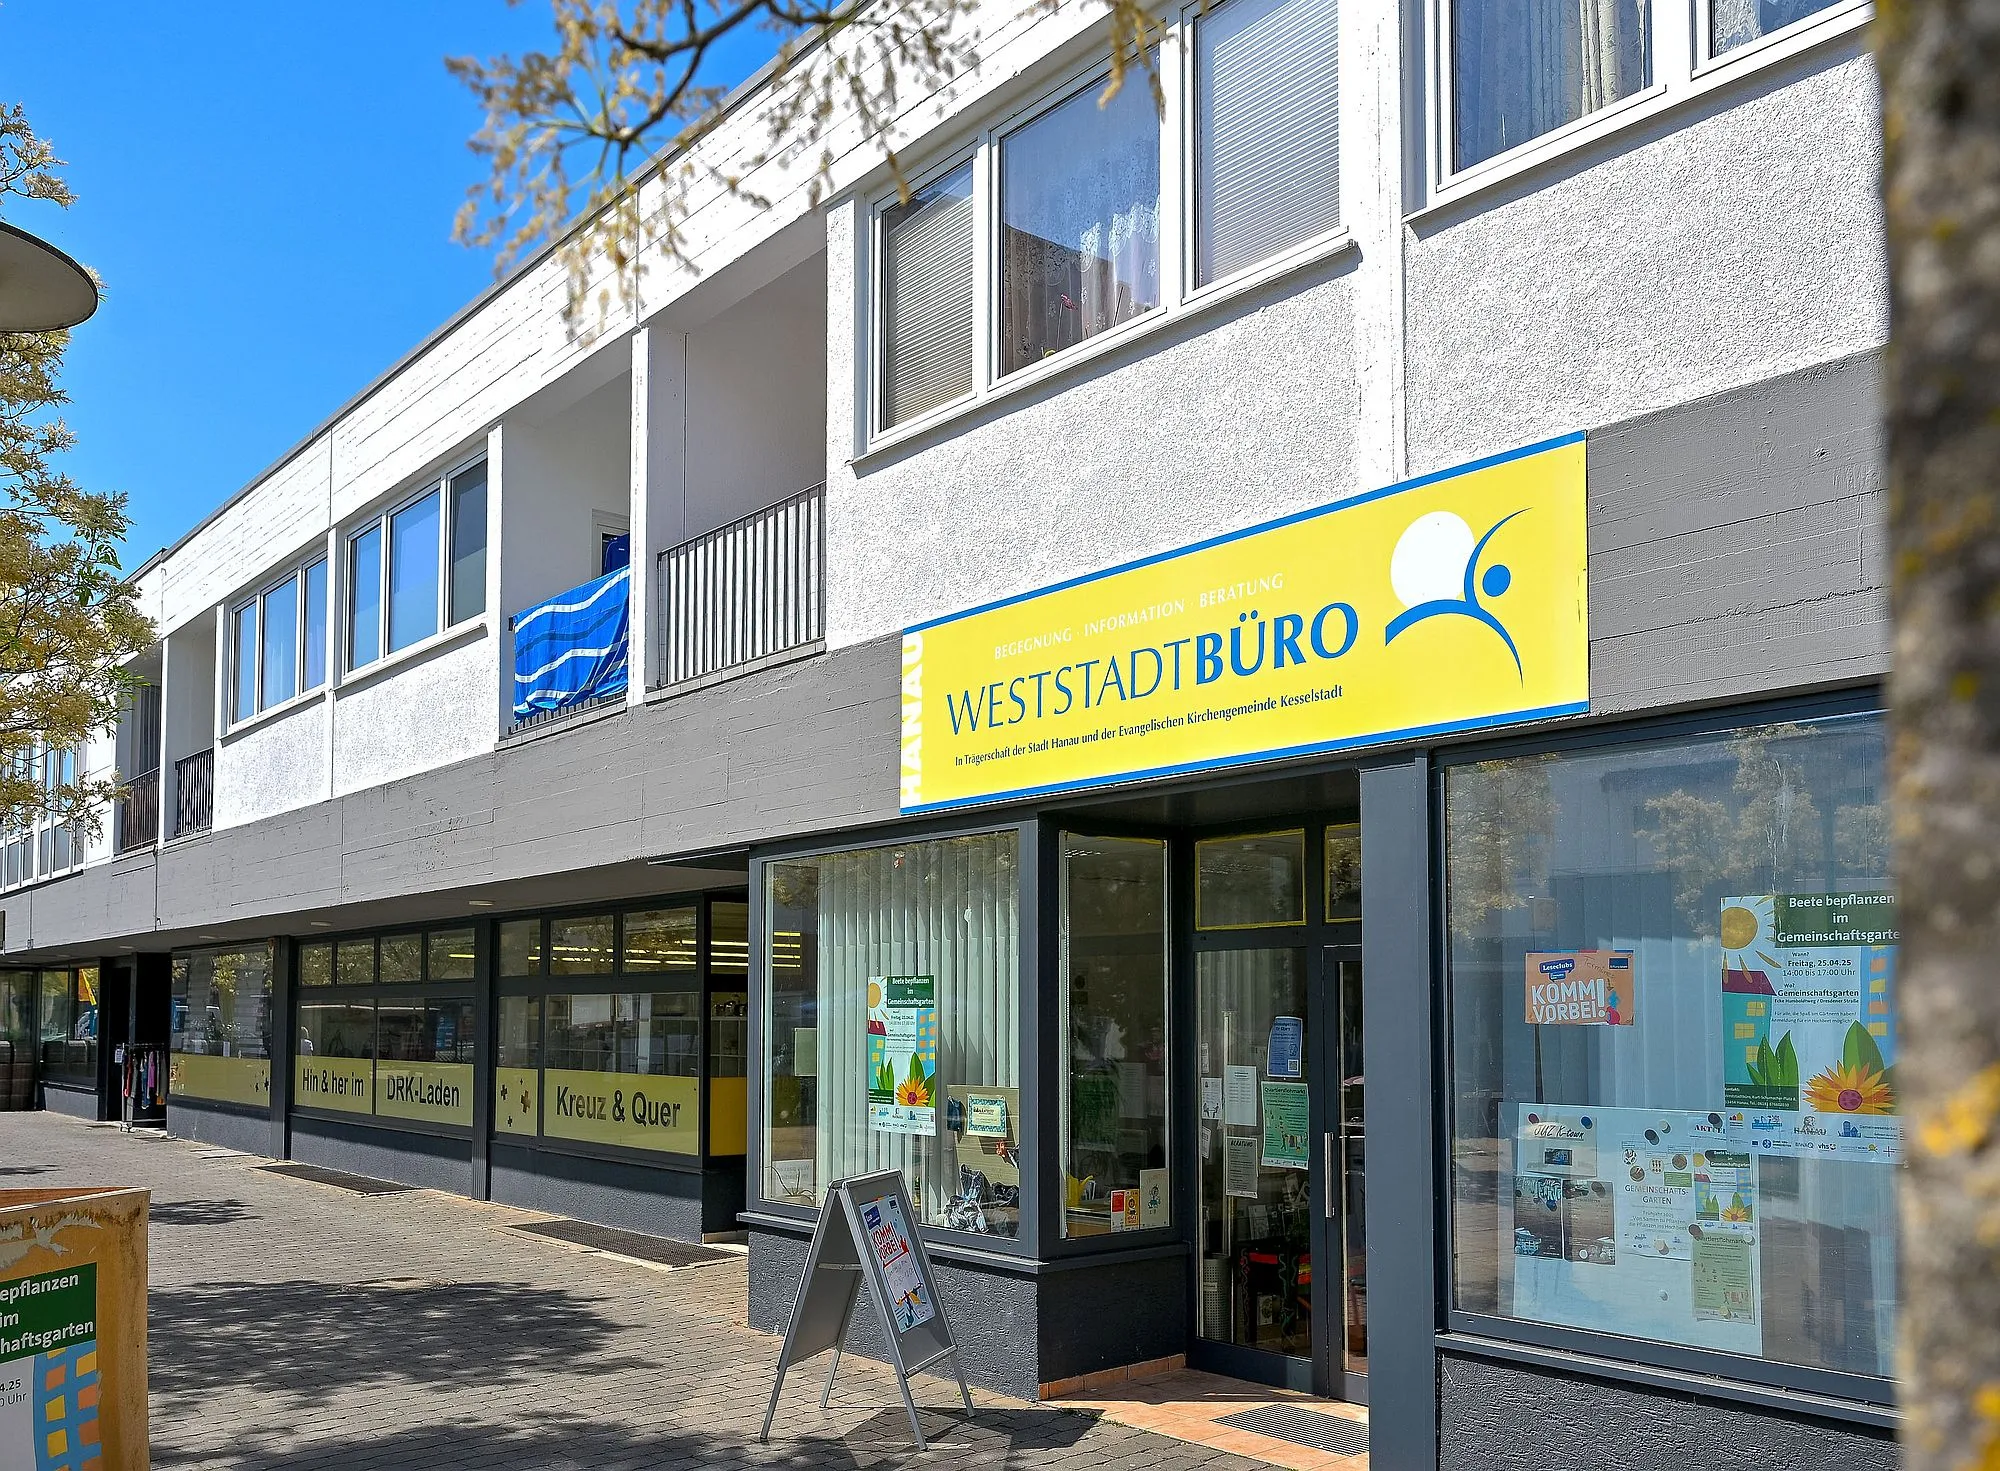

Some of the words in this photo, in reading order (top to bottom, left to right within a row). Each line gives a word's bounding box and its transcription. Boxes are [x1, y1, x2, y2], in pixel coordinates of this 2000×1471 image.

[994, 628, 1072, 660] BEGEGNUNG
[1084, 599, 1185, 637] INFORMATION
[1200, 572, 1284, 608] BERATUNG
[947, 602, 1359, 735] WESTSTADTBÜRO
[900, 632, 923, 807] HANAU
[955, 756, 963, 766] In
[964, 745, 1011, 766] Trägerschaft
[1012, 744, 1026, 756] der
[1028, 738, 1049, 754] Stadt
[1051, 736, 1080, 749] Hanau
[1082, 729, 1099, 744] und
[1101, 729, 1116, 740] der
[1118, 716, 1184, 737] Evangelischen
[1187, 697, 1277, 725] Kirchengemeinde
[1280, 685, 1343, 708] Kesselstadt
[1789, 897, 1823, 908] Beete
[1826, 894, 1895, 909] bepflanzen
[1832, 913, 1849, 924] im
[1777, 929, 1901, 944] Gemeinschaftsgarte
[1543, 961, 1573, 971] Leseclubs
[1788, 960, 1816, 968] Freitag,
[1817, 959, 1852, 967] 25.04.25
[1841, 968, 1856, 976] Uhr
[1777, 989, 1859, 998] Gemeinschaftsgarten
[302, 1068, 318, 1092] Hin
[321, 1070, 328, 1093] &
[332, 1070, 349, 1095] her
[352, 1072, 364, 1096] im
[387, 1075, 459, 1107] DRK-Laden
[556, 1085, 607, 1121] Kreuz
[612, 1089, 625, 1122] &
[632, 1091, 681, 1127] Quer
[0, 1310, 19, 1328] im
[7, 1392, 27, 1405] Uhr
